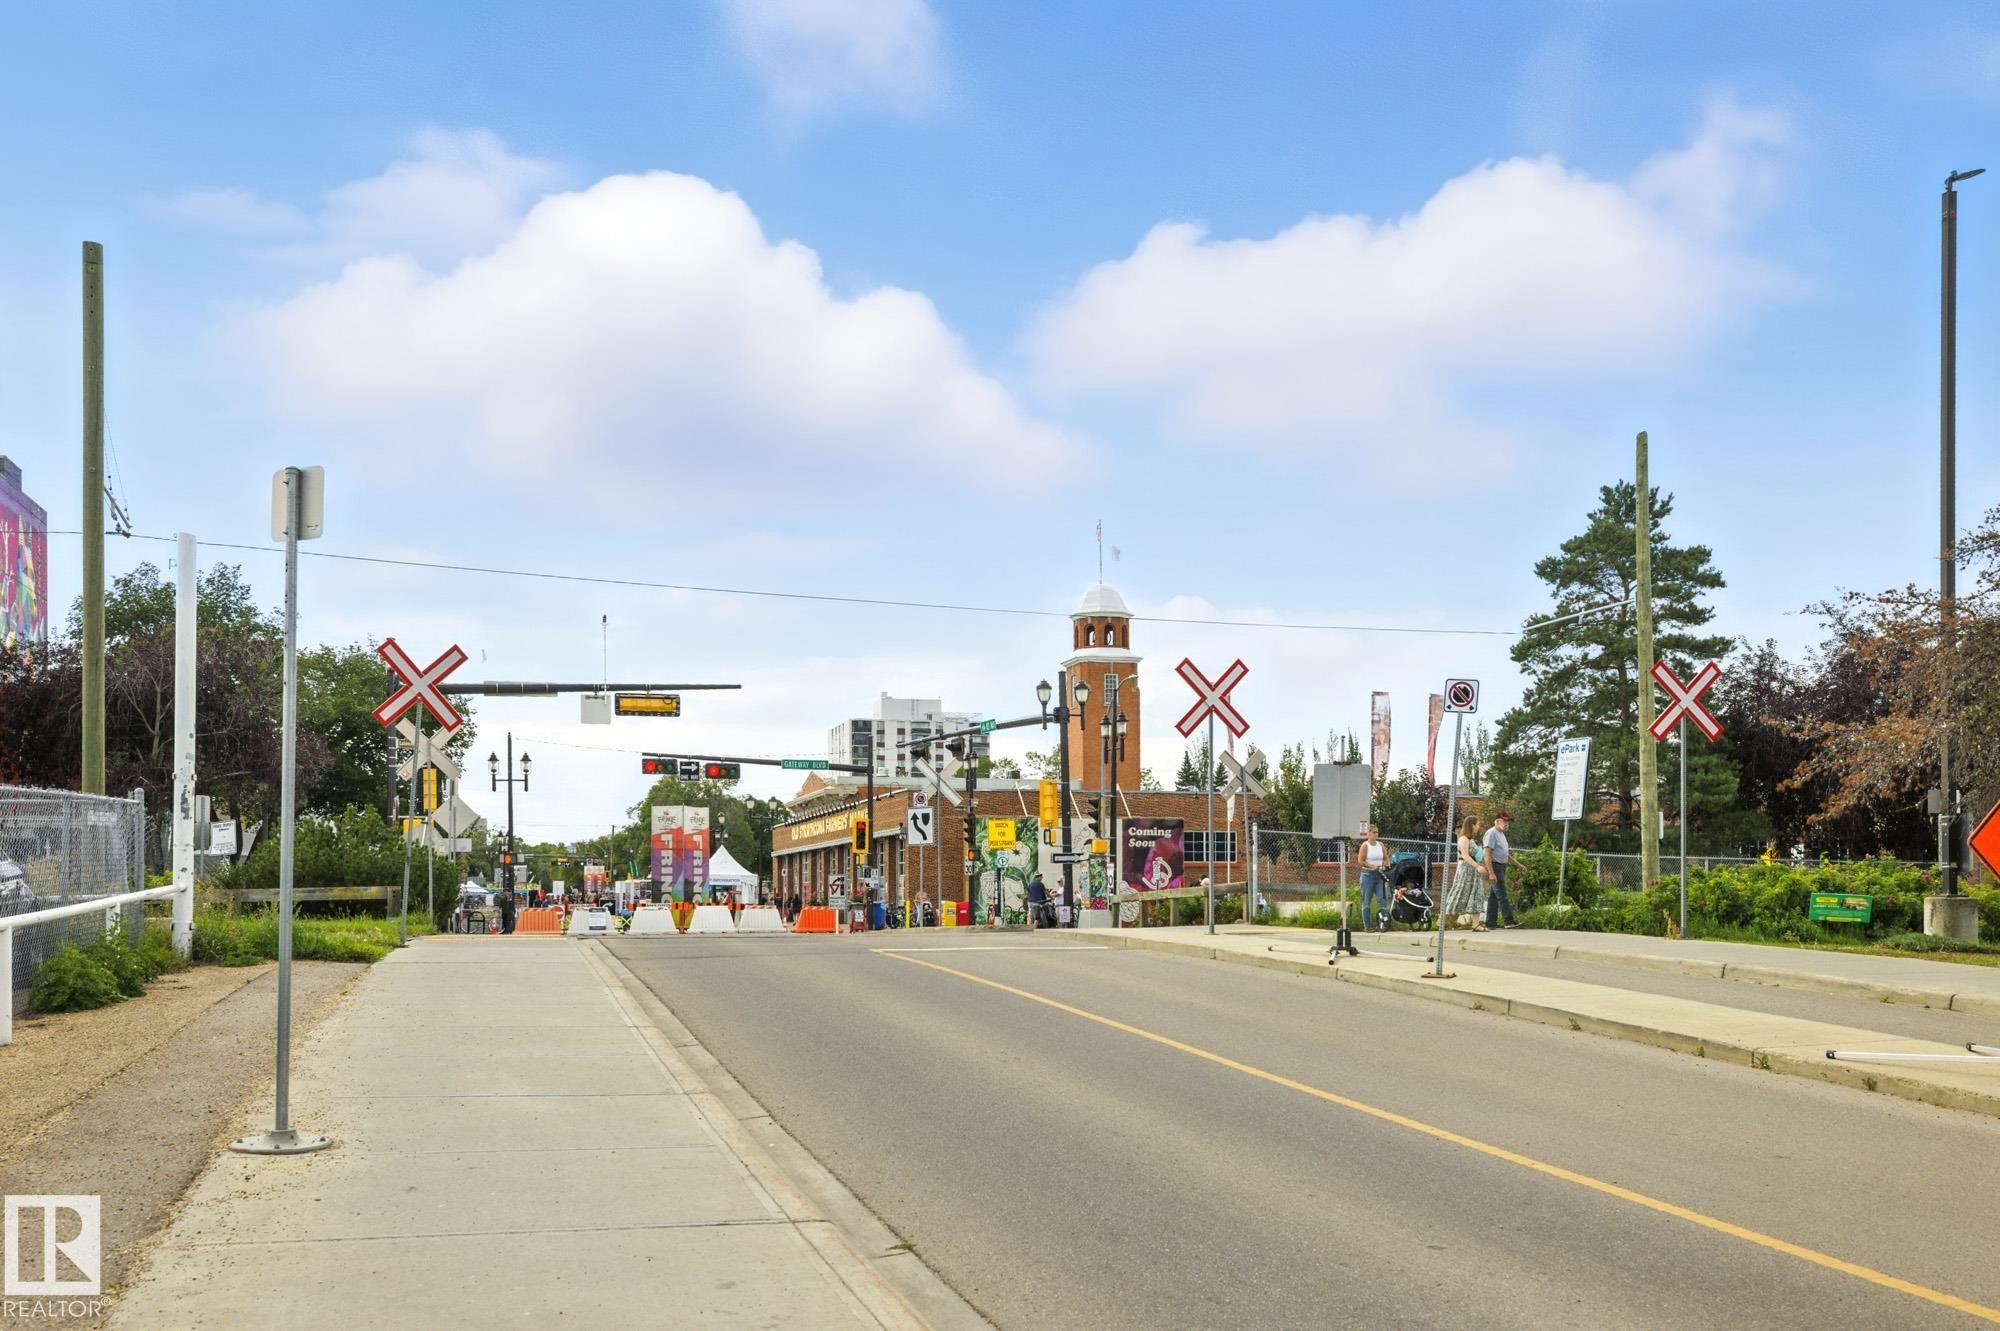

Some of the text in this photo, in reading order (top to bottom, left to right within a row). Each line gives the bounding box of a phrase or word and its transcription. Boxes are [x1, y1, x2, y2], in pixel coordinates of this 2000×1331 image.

[1561, 742, 1580, 754] ePark
[784, 760, 826, 769] GATEWAY BLVD
[1128, 826, 1172, 838] Coming
[1128, 838, 1156, 848] Soon
